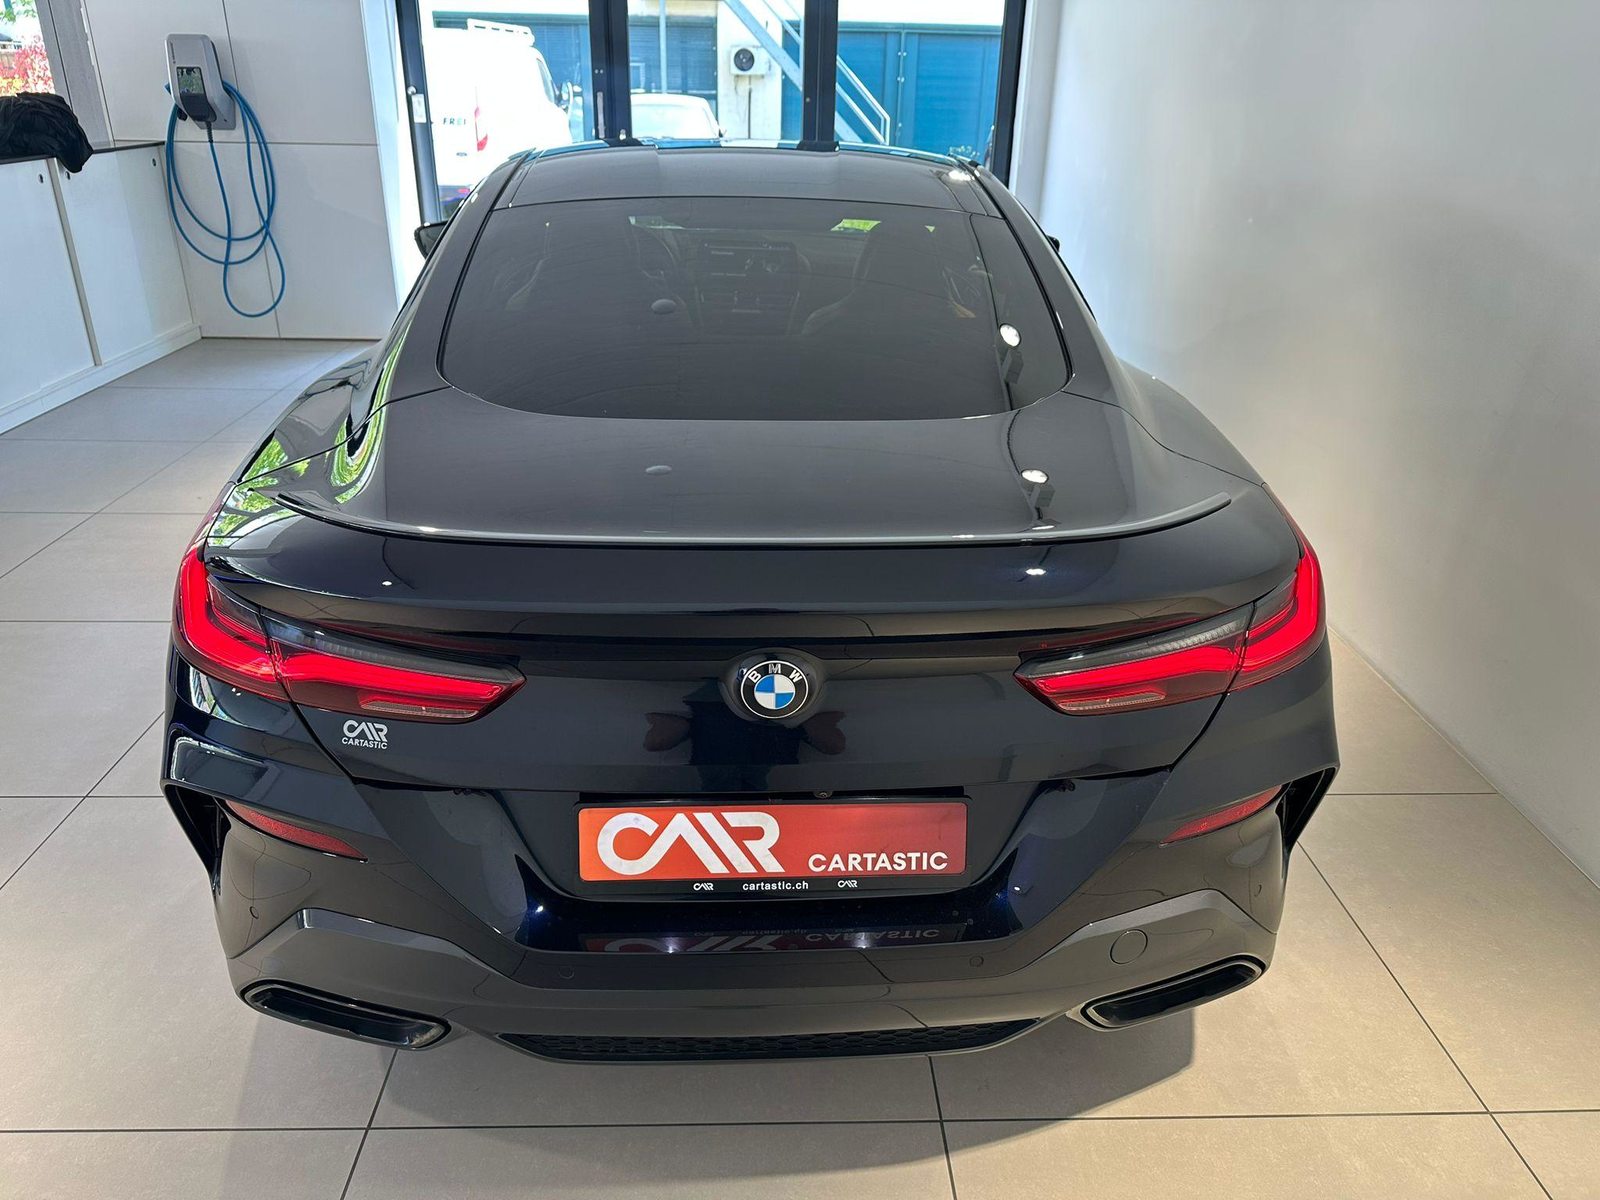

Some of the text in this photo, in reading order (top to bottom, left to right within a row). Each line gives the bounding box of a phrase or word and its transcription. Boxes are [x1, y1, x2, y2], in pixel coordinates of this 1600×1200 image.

[443, 117, 466, 125] FREI
[748, 663, 803, 683] BMW
[341, 737, 388, 749] CARTASTIC
[807, 851, 949, 873] CARTASTIC
[742, 880, 809, 891] cartastic.ch
